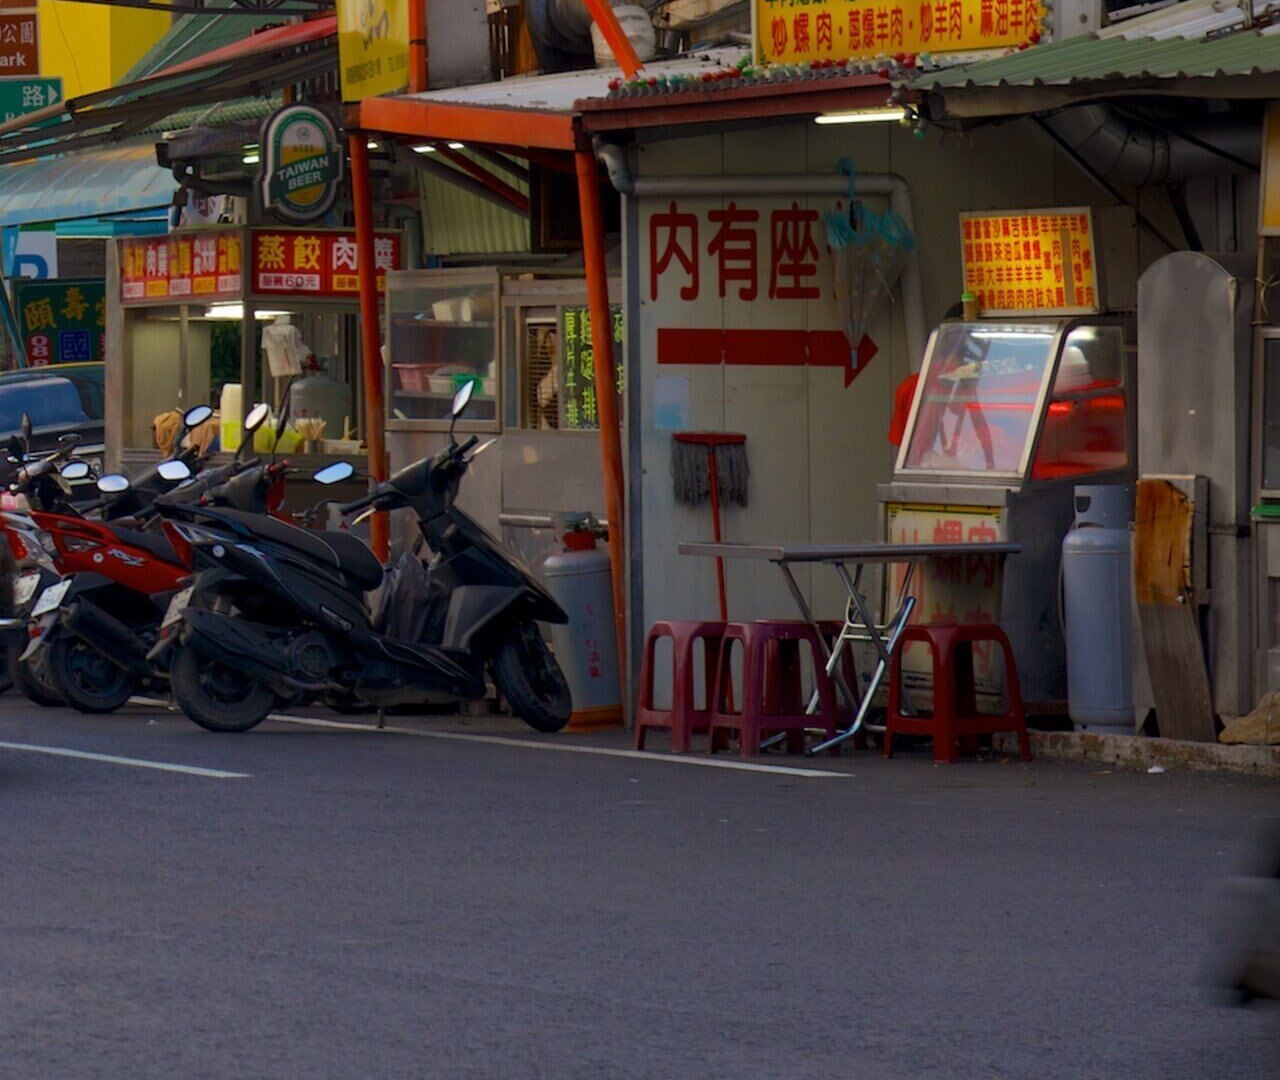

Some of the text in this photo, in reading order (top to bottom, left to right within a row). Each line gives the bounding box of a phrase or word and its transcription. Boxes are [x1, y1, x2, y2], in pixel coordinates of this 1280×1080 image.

[277, 156, 330, 181] TAIWAN
[287, 170, 323, 191] BEER
[258, 234, 321, 270] 蒸餃
